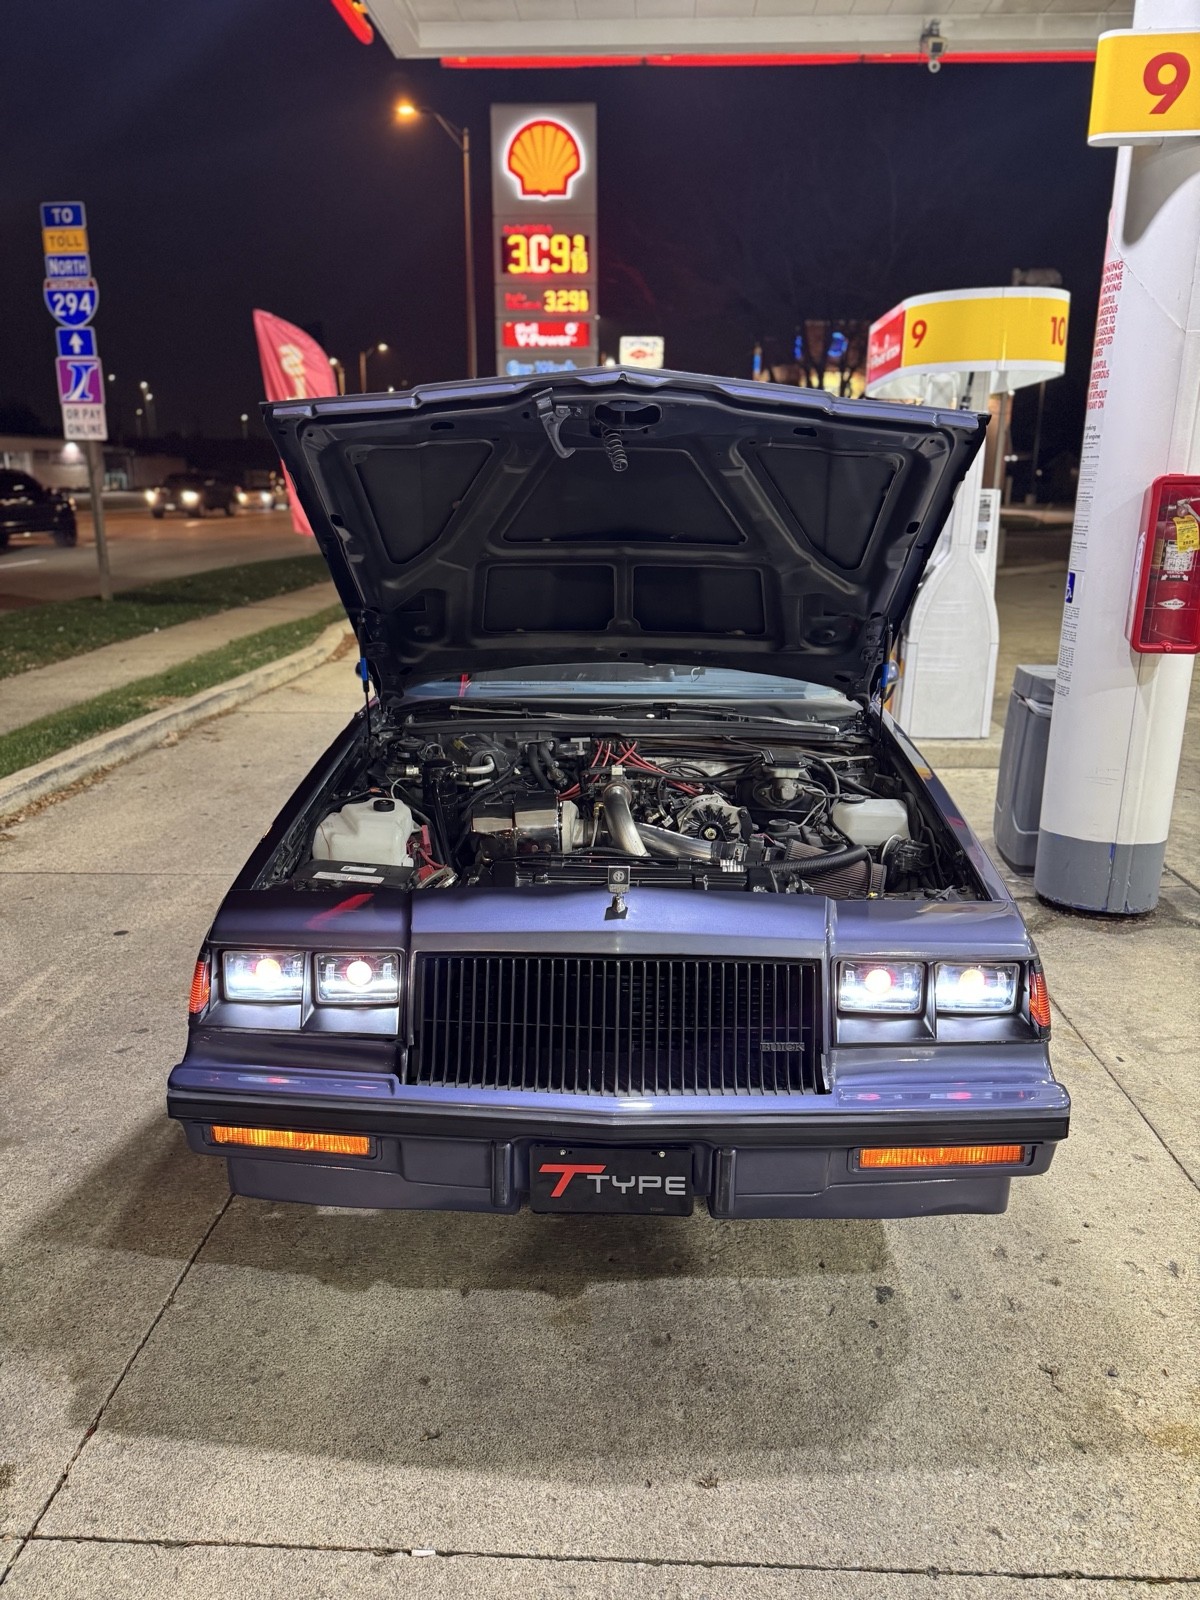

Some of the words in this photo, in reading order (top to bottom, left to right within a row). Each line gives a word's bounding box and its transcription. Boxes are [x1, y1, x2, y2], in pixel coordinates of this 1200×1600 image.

[1143, 52, 1191, 115] 9
[51, 207, 73, 224] TO
[49, 235, 82, 247] TOLL
[48, 257, 87, 276] NORTH
[54, 293, 92, 316] 294
[911, 319, 927, 348] 9
[1051, 316, 1065, 346] 10
[66, 408, 80, 420] OR
[82, 408, 101, 420] PAY
[68, 424, 103, 435] ONLINE
[760, 1042, 805, 1052] BUICK
[586, 1175, 686, 1196] TYPE
